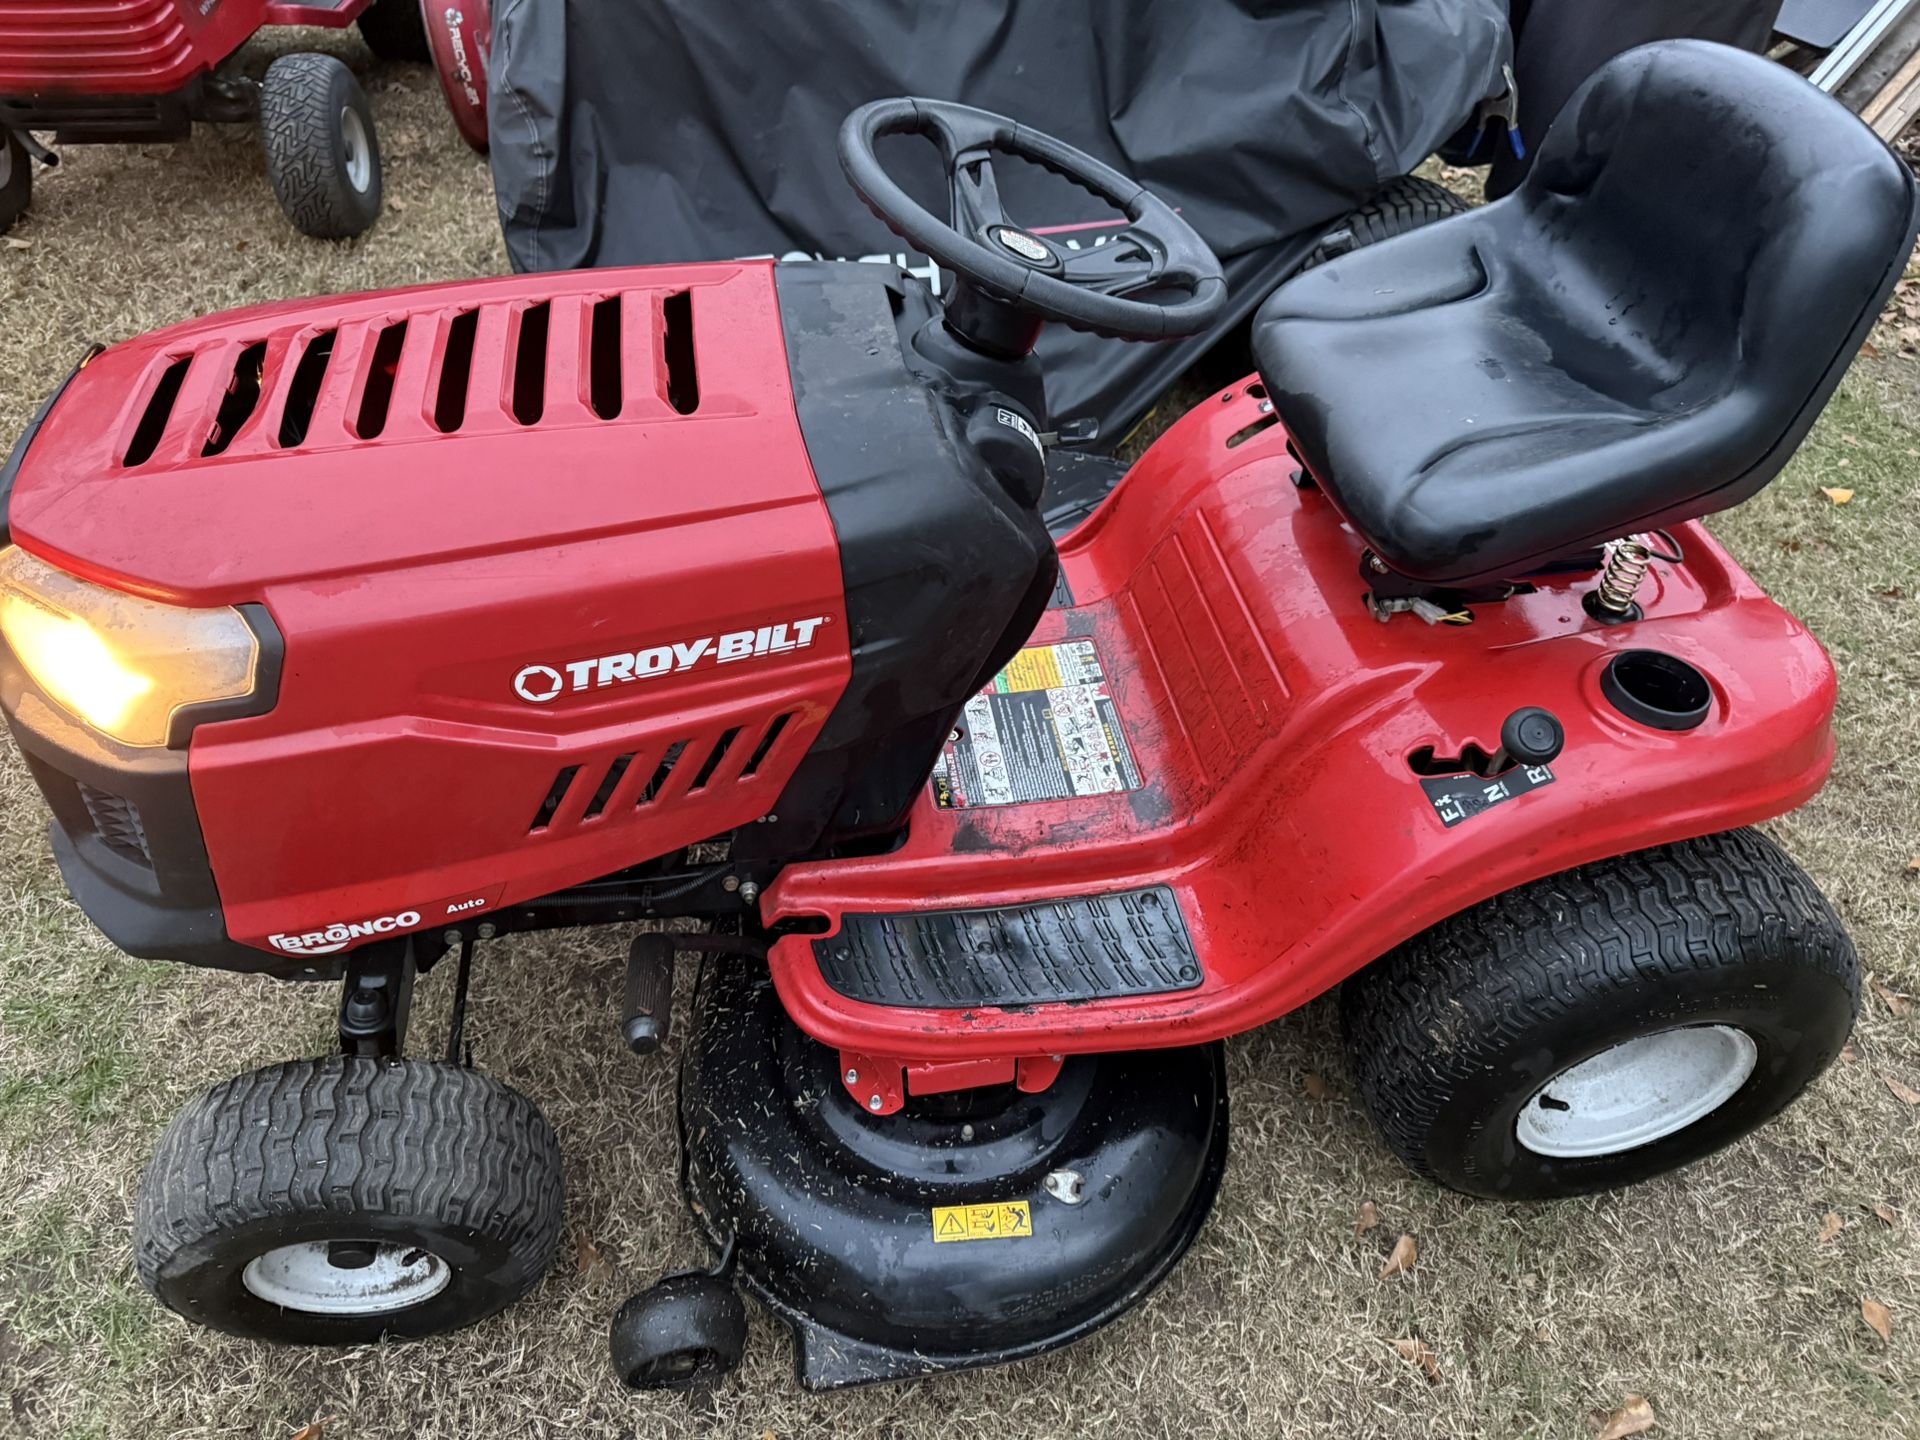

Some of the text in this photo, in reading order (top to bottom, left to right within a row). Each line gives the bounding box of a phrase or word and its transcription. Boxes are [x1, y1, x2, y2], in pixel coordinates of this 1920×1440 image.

[566, 617, 823, 691] TROY-BILT
[946, 752, 960, 788] DANGER
[1527, 766, 1546, 785] R
[1483, 784, 1504, 802] N
[1440, 808, 1460, 823] F
[274, 897, 486, 952] BRONCO Auto
